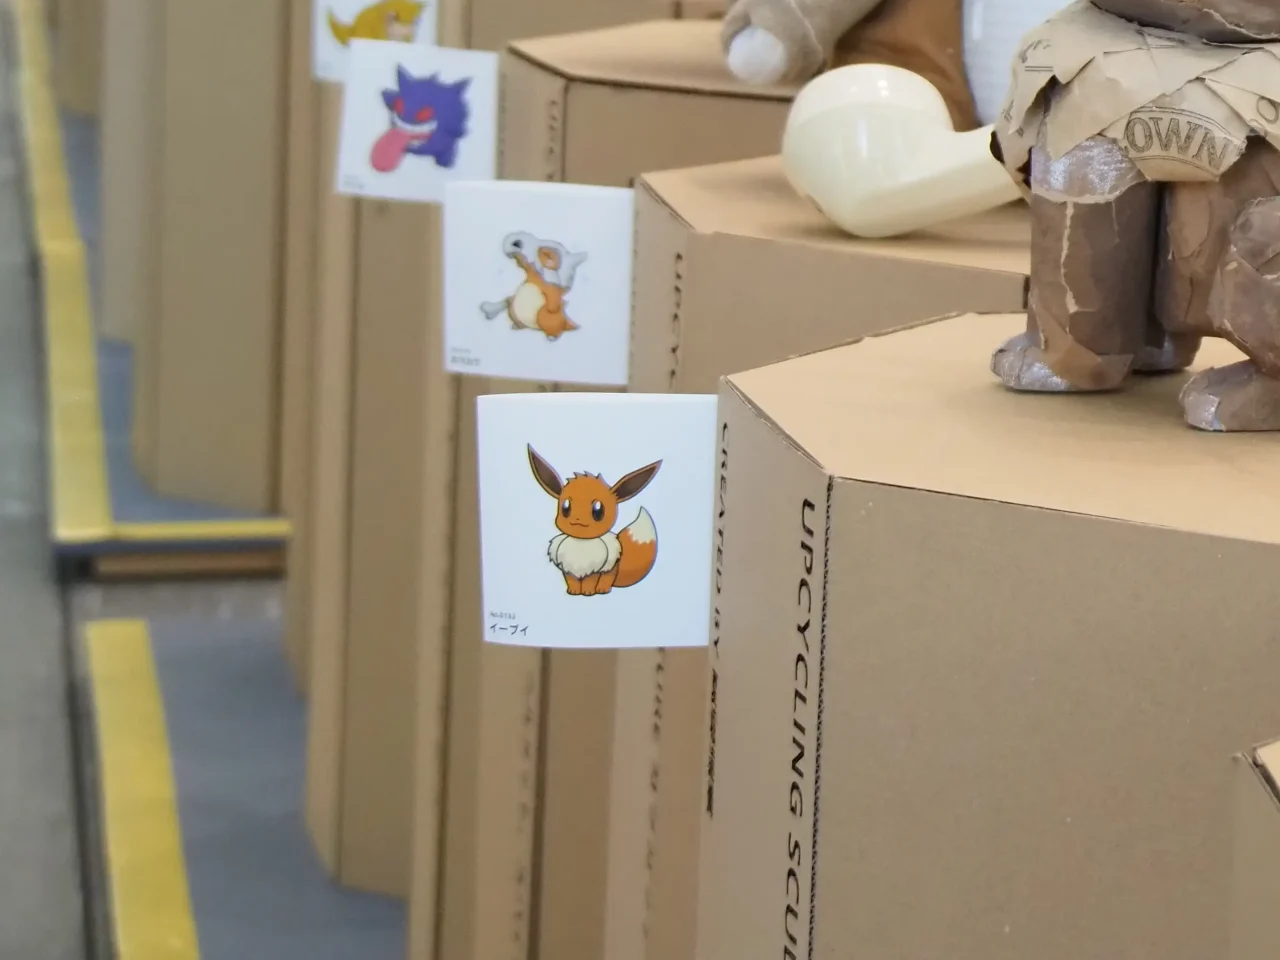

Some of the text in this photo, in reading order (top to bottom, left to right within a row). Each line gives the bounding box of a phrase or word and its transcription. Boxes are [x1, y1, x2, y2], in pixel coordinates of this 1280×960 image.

[1123, 116, 1232, 171] OWN
[716, 421, 729, 595] CREATED
[789, 497, 816, 818] UPCYCLING
